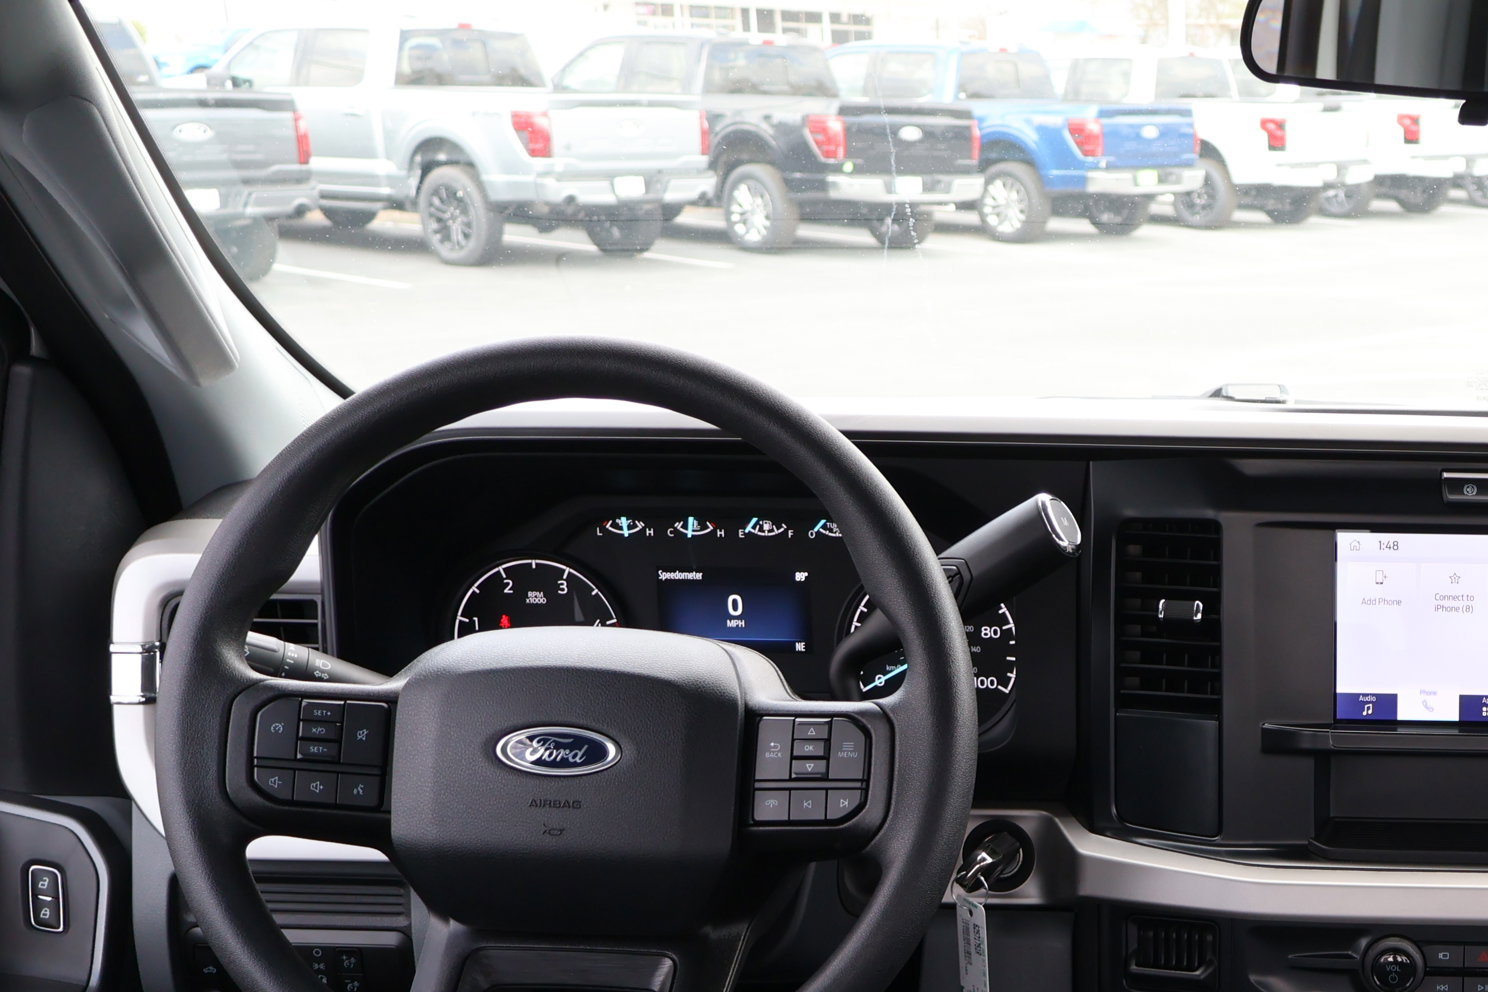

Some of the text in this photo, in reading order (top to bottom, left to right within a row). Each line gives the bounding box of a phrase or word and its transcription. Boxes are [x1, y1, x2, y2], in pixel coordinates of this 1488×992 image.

[596, 527, 603, 536] L
[646, 528, 655, 537] H
[667, 528, 675, 537] C
[717, 528, 725, 538] H
[738, 529, 745, 538] E
[788, 529, 795, 539] F
[1378, 540, 1399, 551] 1:48
[658, 570, 703, 581] Speedometer
[503, 579, 513, 594] 2
[557, 580, 568, 594] 3
[1361, 597, 1402, 607] Add Phone
[1434, 592, 1474, 602] Connect to
[727, 594, 743, 616] 0
[1434, 604, 1474, 614] iPhone (8)
[473, 618, 478, 631] 1
[727, 619, 745, 628] MPH
[981, 626, 1000, 639] 80
[795, 642, 806, 652] NE
[1419, 689, 1438, 697] Phone
[1359, 694, 1376, 703] Audio
[525, 735, 589, 763] Ford
[528, 798, 582, 810] AIRBAG
